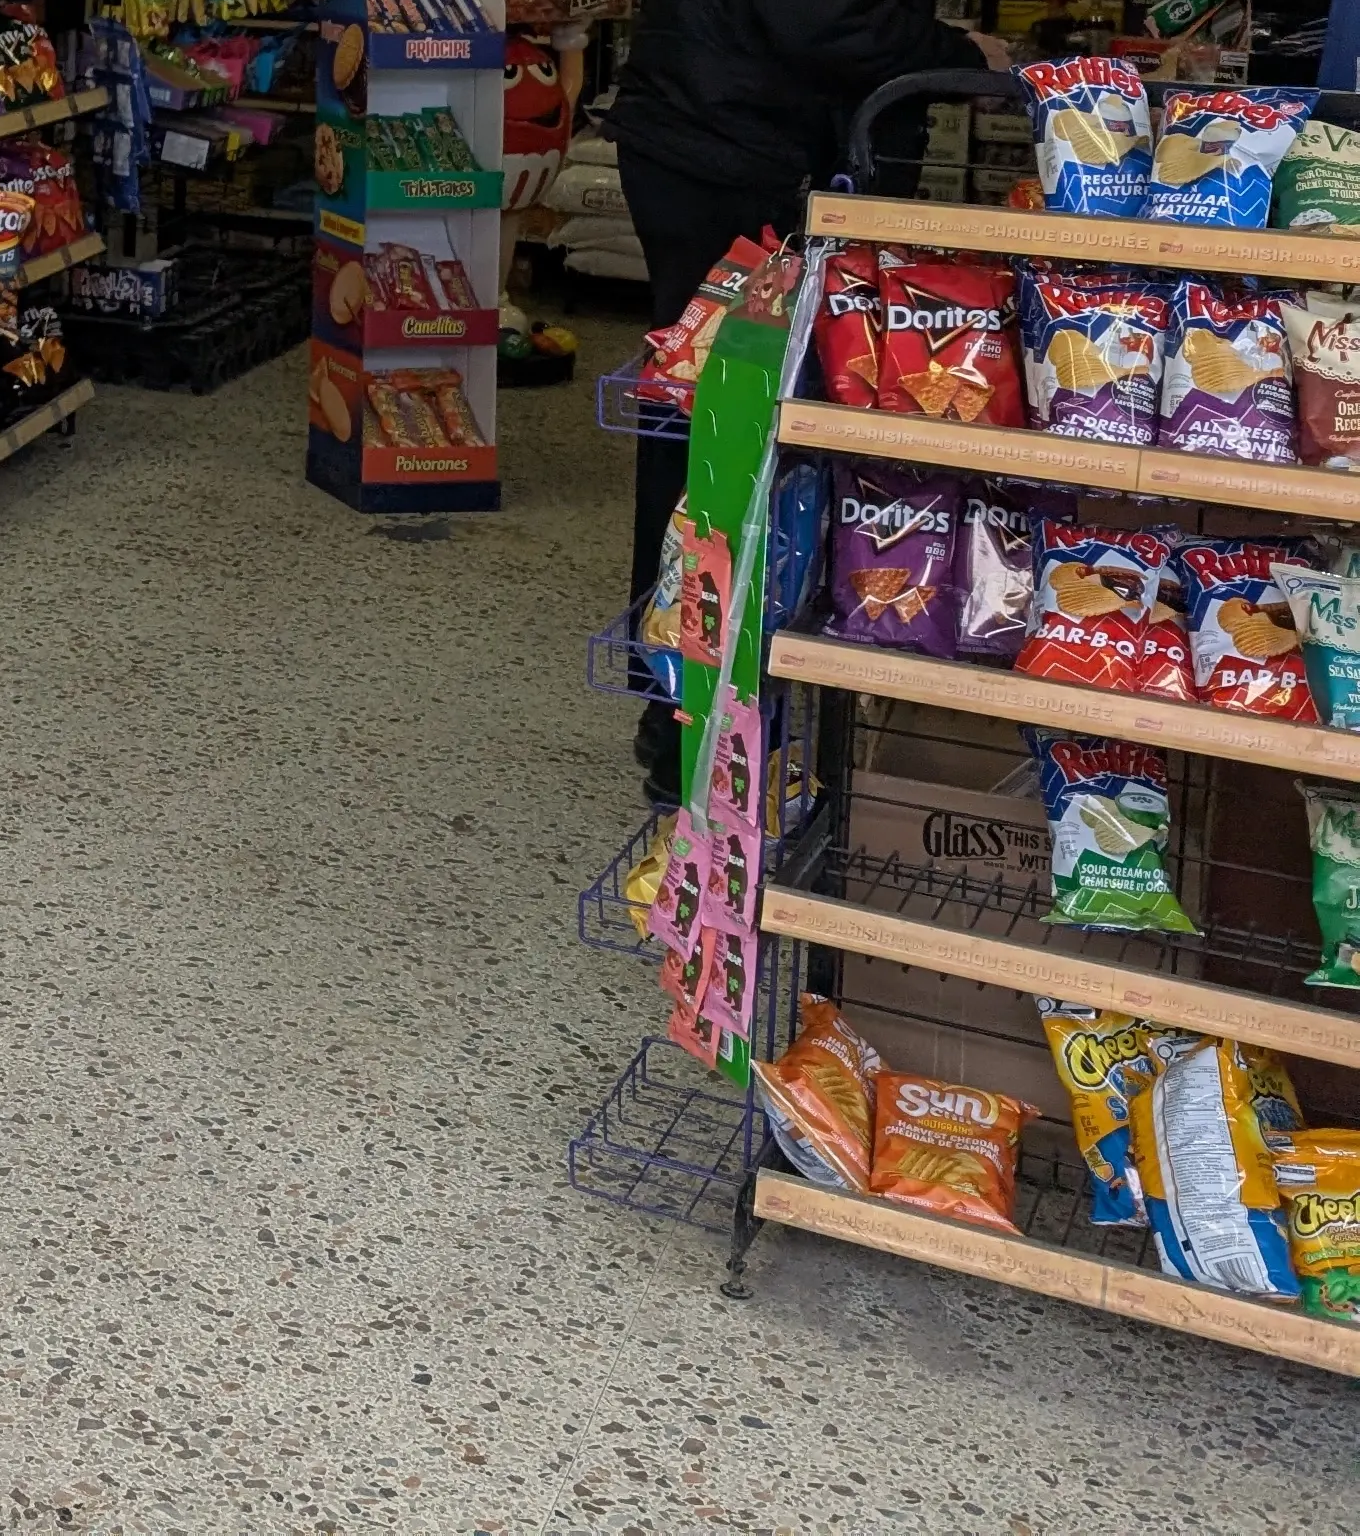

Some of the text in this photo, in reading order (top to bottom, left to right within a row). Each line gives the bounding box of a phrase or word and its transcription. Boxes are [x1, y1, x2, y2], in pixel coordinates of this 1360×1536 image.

[1168, 1, 1195, 23] excel
[1023, 56, 1142, 102] Ruffles
[1152, 192, 1229, 208] REGULAR
[873, 215, 1151, 251] PLAISIR DANS CHAQUE BOUCHÉE
[1213, 242, 1336, 265] PLAISIR DANS
[404, 316, 466, 336] Canelitas
[888, 305, 1002, 331] Doritos
[965, 340, 1002, 356] NACHO
[1088, 417, 1154, 442] DRESSED
[1190, 418, 1219, 434] ALL
[395, 454, 468, 473] Polvorones
[842, 496, 951, 534] Doritos
[1036, 624, 1137, 657] BAR-B-Q
[1222, 668, 1309, 690] BAR-B-
[923, 813, 1039, 860] Glass THIS
[1081, 864, 1107, 878] SOUR
[1112, 877, 1137, 891] SURE
[895, 1083, 999, 1129] Sun
[885, 1126, 937, 1149] CHEDDAR
[898, 1119, 951, 1142] HARVEST
